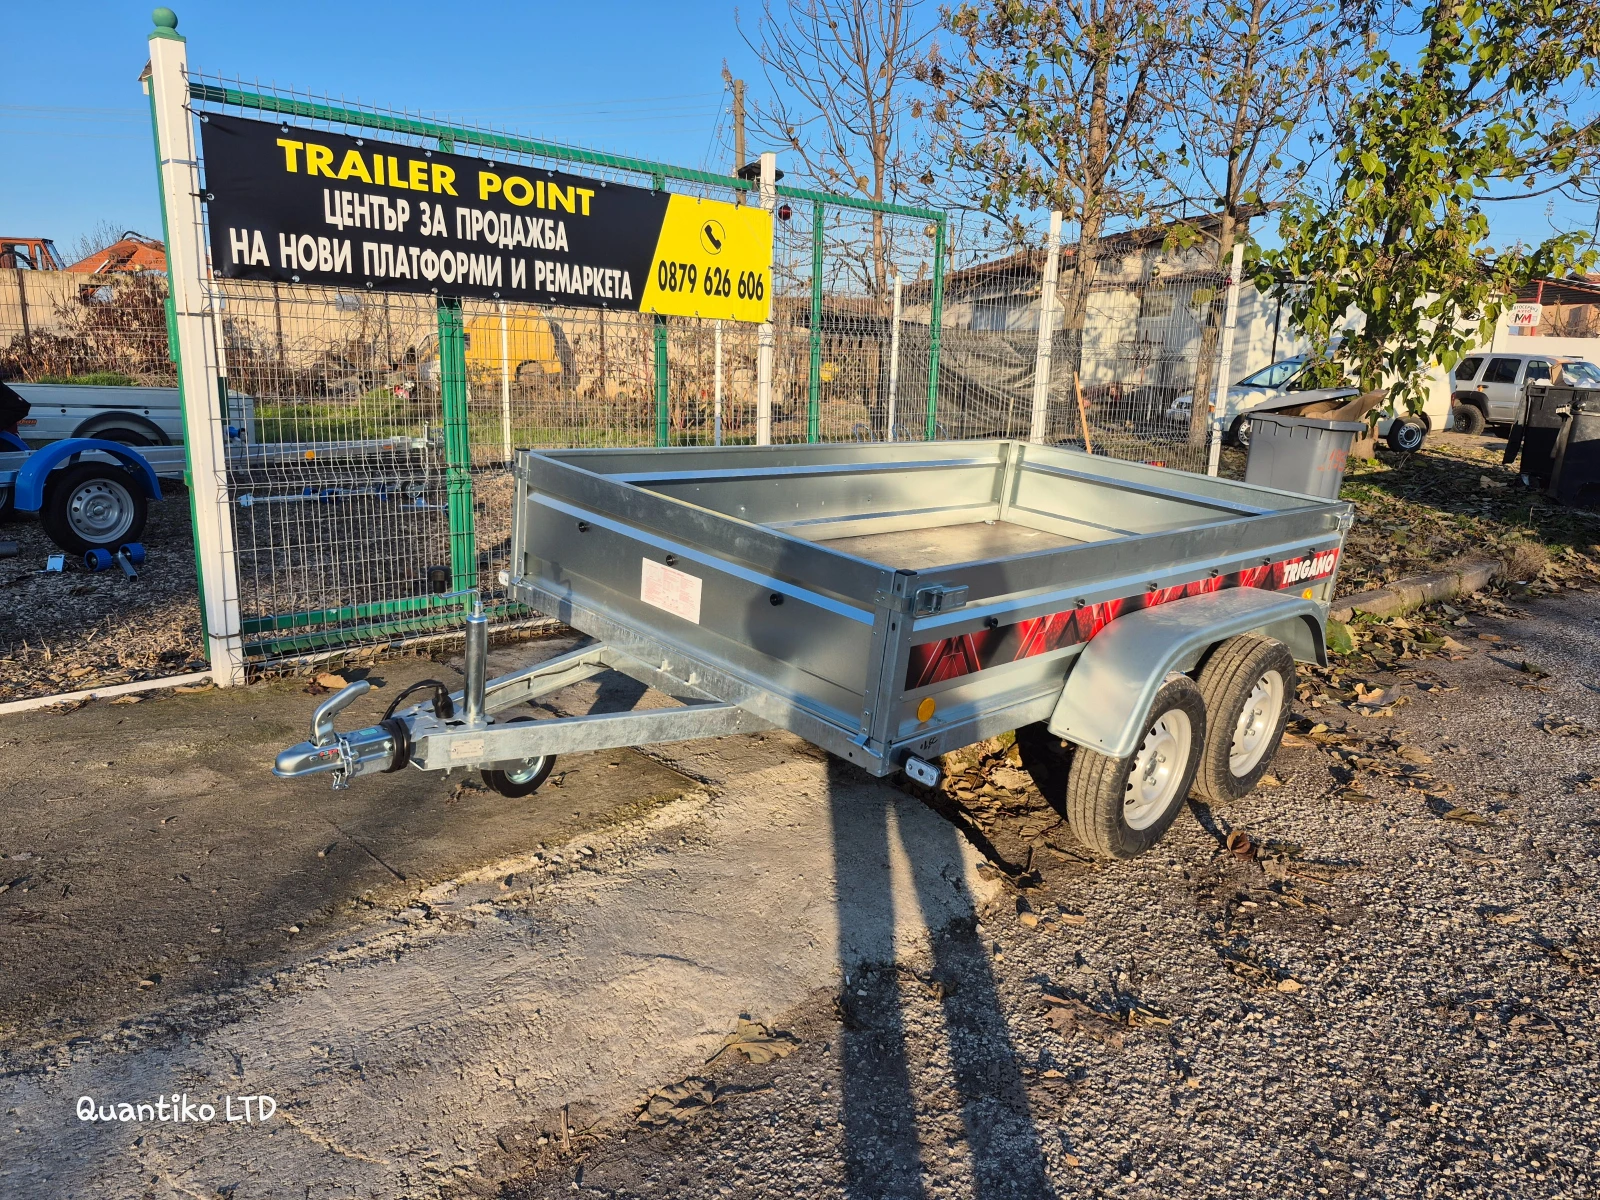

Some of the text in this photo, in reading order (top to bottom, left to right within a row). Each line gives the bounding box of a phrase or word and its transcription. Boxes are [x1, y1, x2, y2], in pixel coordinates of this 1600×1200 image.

[276, 138, 595, 216] TRAILER POINT
[323, 187, 569, 252] ЦЕНТЪР ЗА ПРОДАЖБА
[229, 227, 633, 300] НА НОВИ ПЛАТФОРМИ И РЕМАРКЕТА
[657, 259, 764, 301] 0879 626 606
[1282, 553, 1335, 584] TRIGANO
